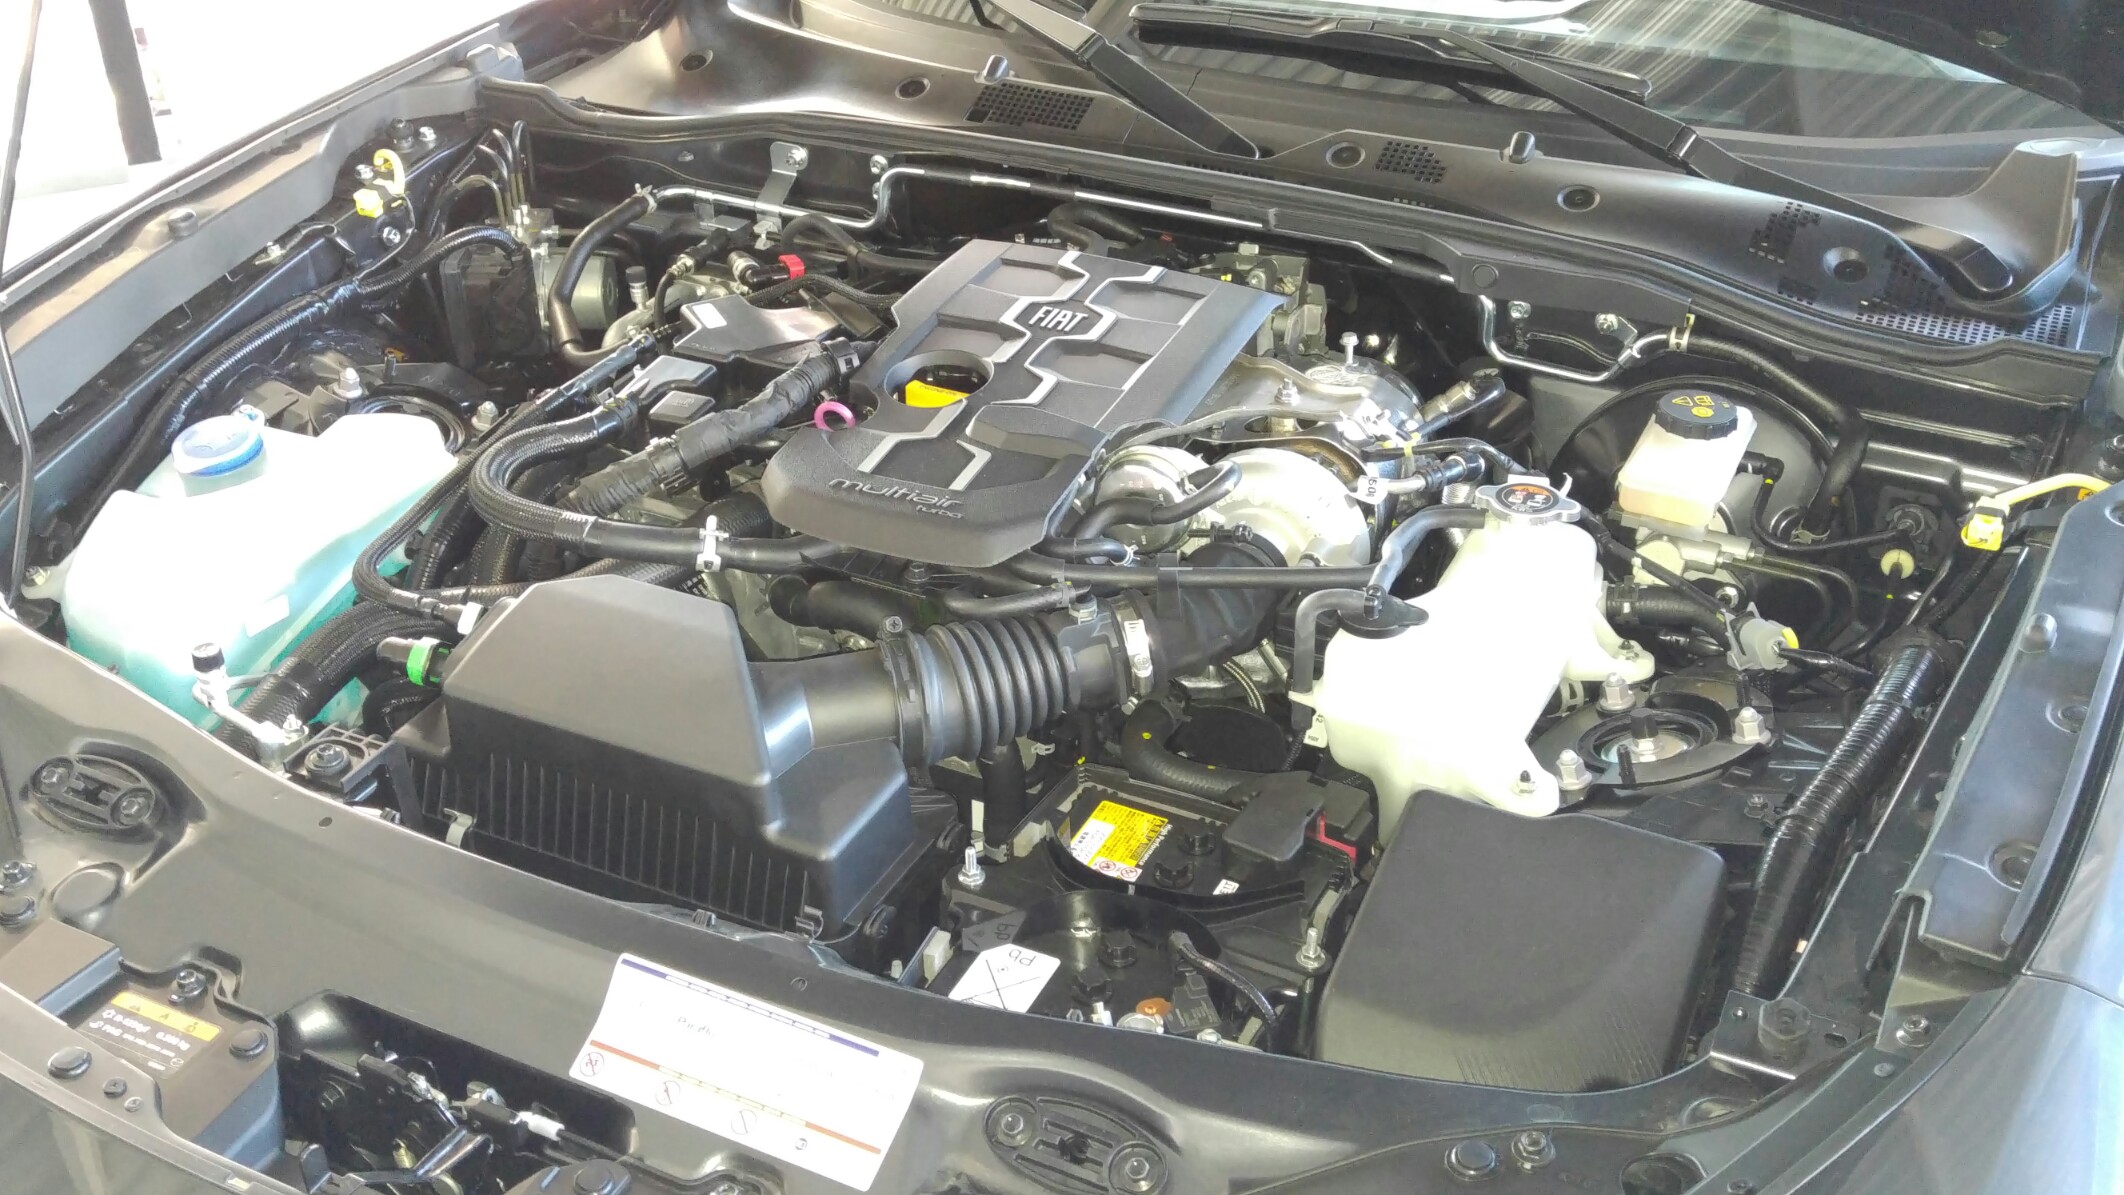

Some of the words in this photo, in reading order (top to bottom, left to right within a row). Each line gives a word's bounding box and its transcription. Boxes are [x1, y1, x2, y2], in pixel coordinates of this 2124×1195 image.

[1028, 305, 1089, 332] FIAT
[828, 478, 966, 508] multiair
[915, 504, 964, 519] turbo
[1137, 835, 1166, 867] Performance
